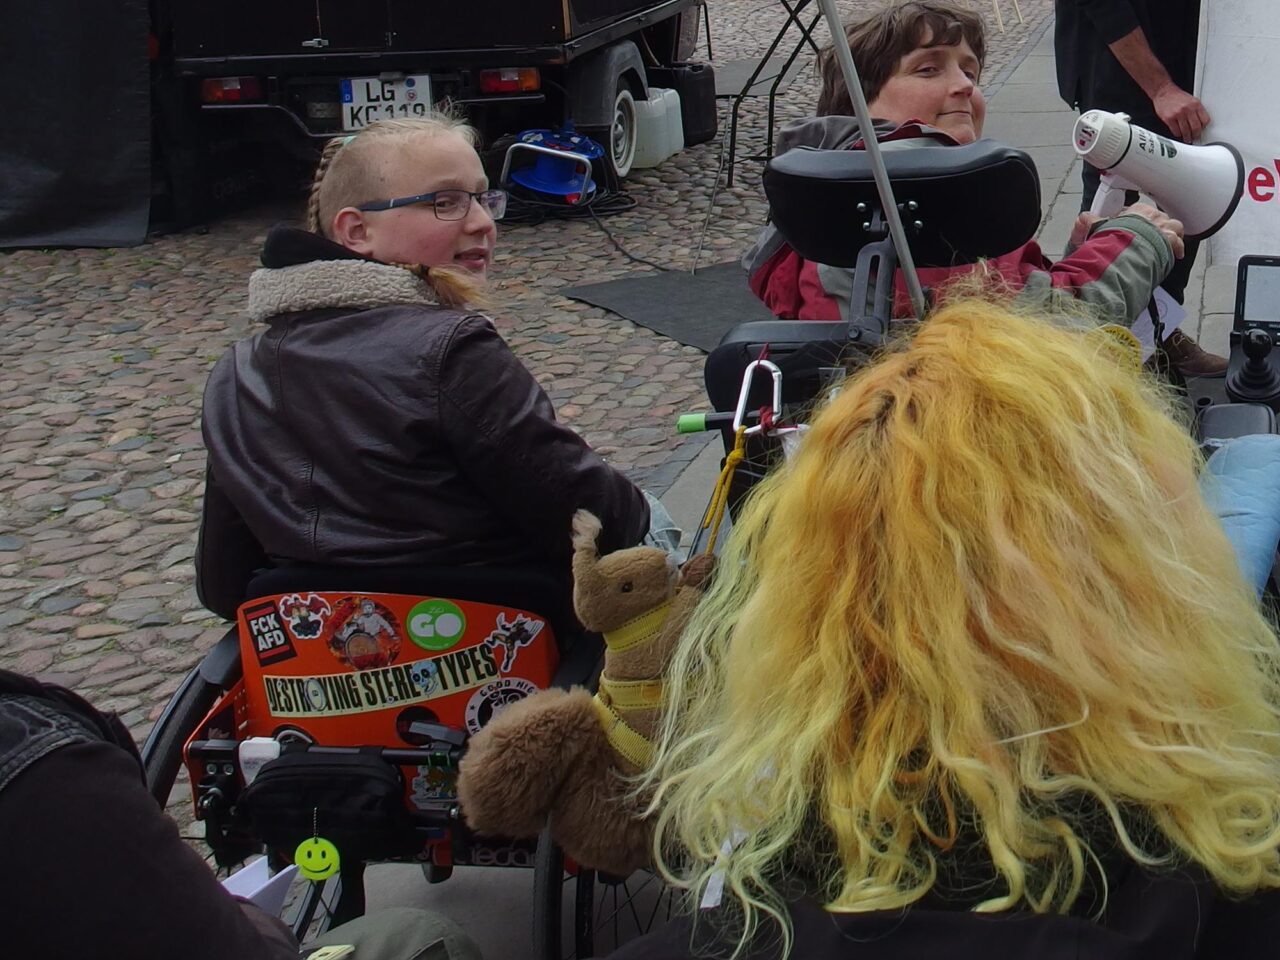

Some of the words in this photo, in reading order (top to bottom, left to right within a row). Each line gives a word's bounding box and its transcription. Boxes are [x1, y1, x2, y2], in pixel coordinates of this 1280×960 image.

[366, 81, 395, 102] LG
[250, 613, 280, 636] FCK
[257, 629, 286, 652] AFD
[480, 679, 511, 697] GOOD
